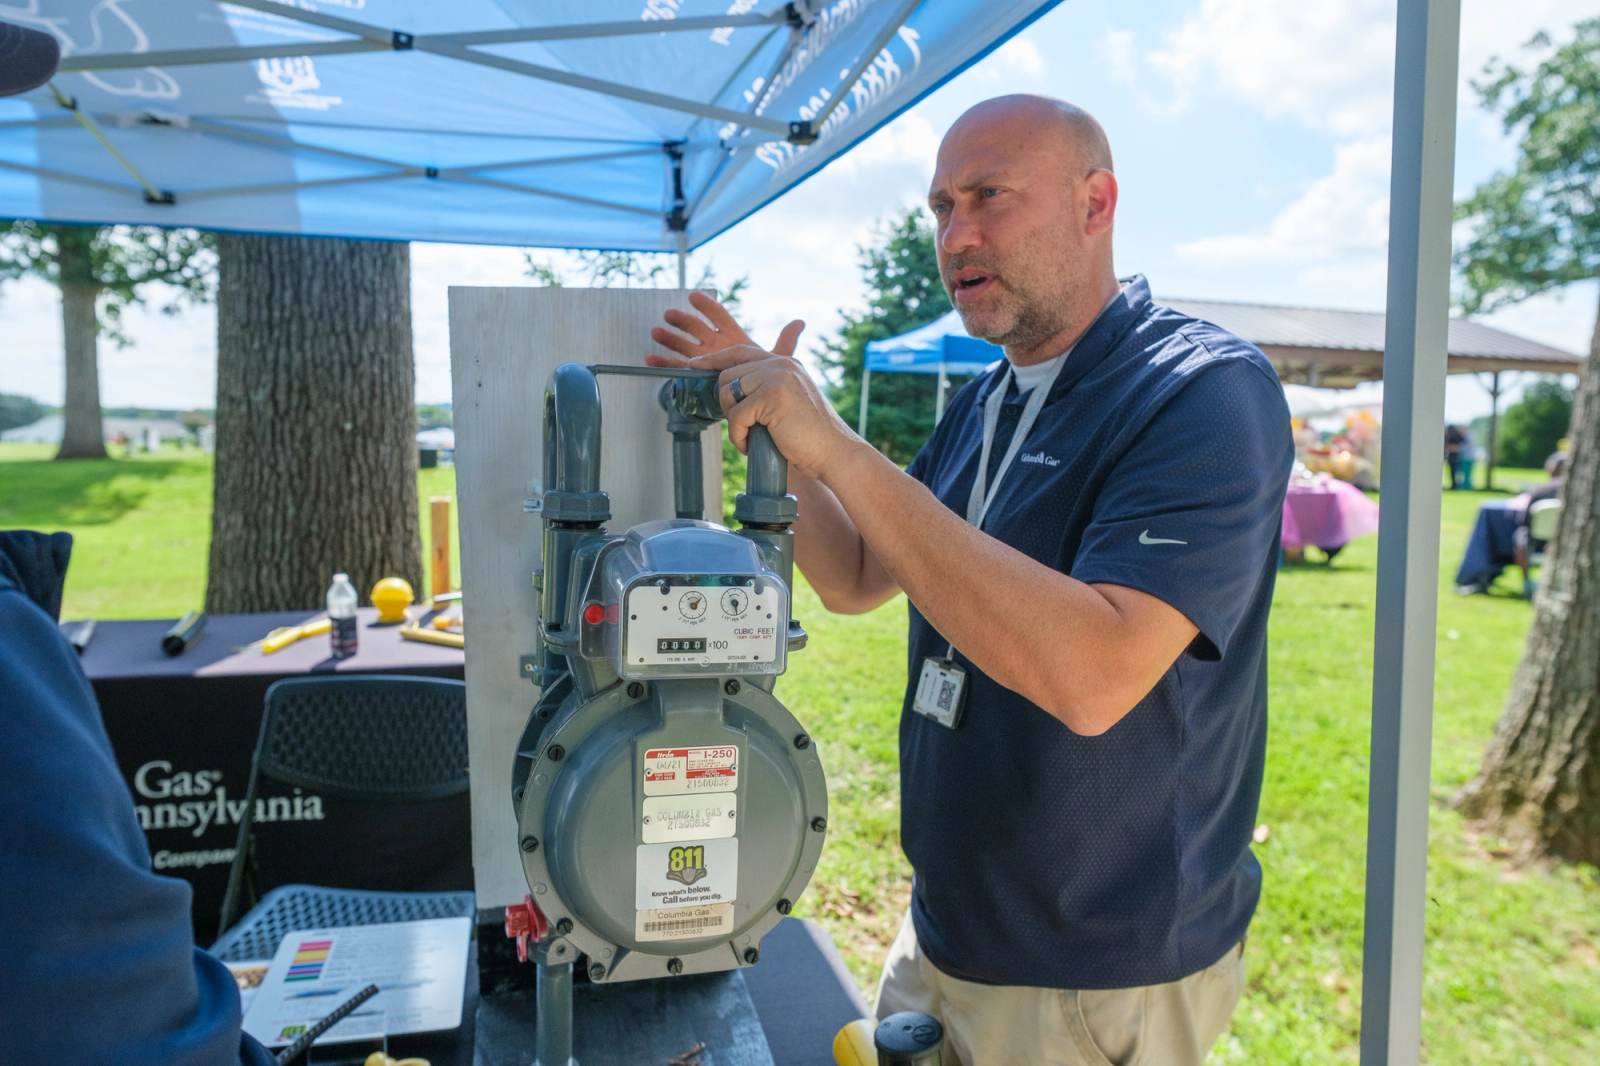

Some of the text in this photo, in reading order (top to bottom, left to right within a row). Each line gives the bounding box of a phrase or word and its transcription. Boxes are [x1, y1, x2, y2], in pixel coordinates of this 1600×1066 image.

[134, 760, 213, 799] Gas
[134, 787, 325, 838] nnsylvnia
[668, 845, 705, 872] 811
[662, 896, 678, 904] Call
[679, 895, 699, 903] before
[657, 908, 710, 920] Columbia Gas
